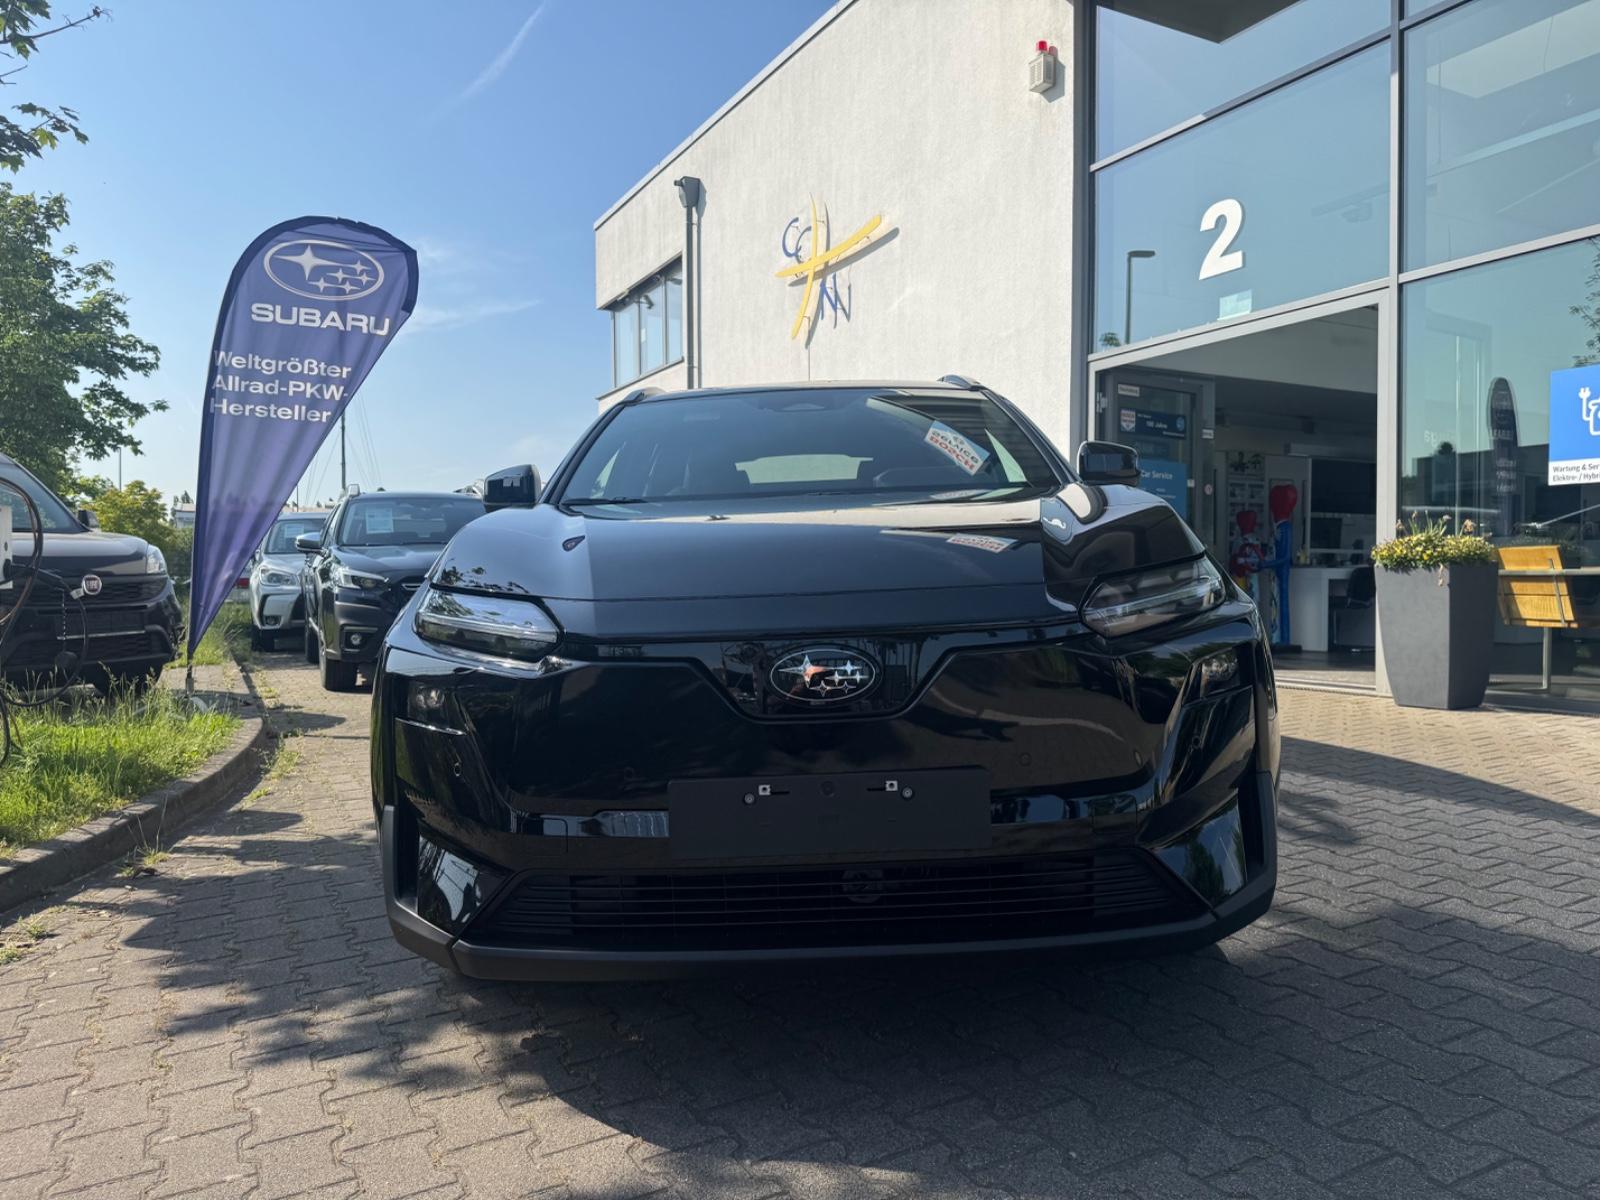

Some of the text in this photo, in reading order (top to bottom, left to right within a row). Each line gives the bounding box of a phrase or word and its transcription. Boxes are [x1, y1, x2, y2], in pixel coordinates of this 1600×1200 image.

[1199, 198, 1243, 280] 2
[251, 302, 390, 336] SUBARU
[214, 350, 352, 379] Weltgrößter
[212, 374, 349, 401] Allrad-PKW-
[209, 397, 332, 423] Hersteller
[1553, 465, 1580, 473] Wartung
